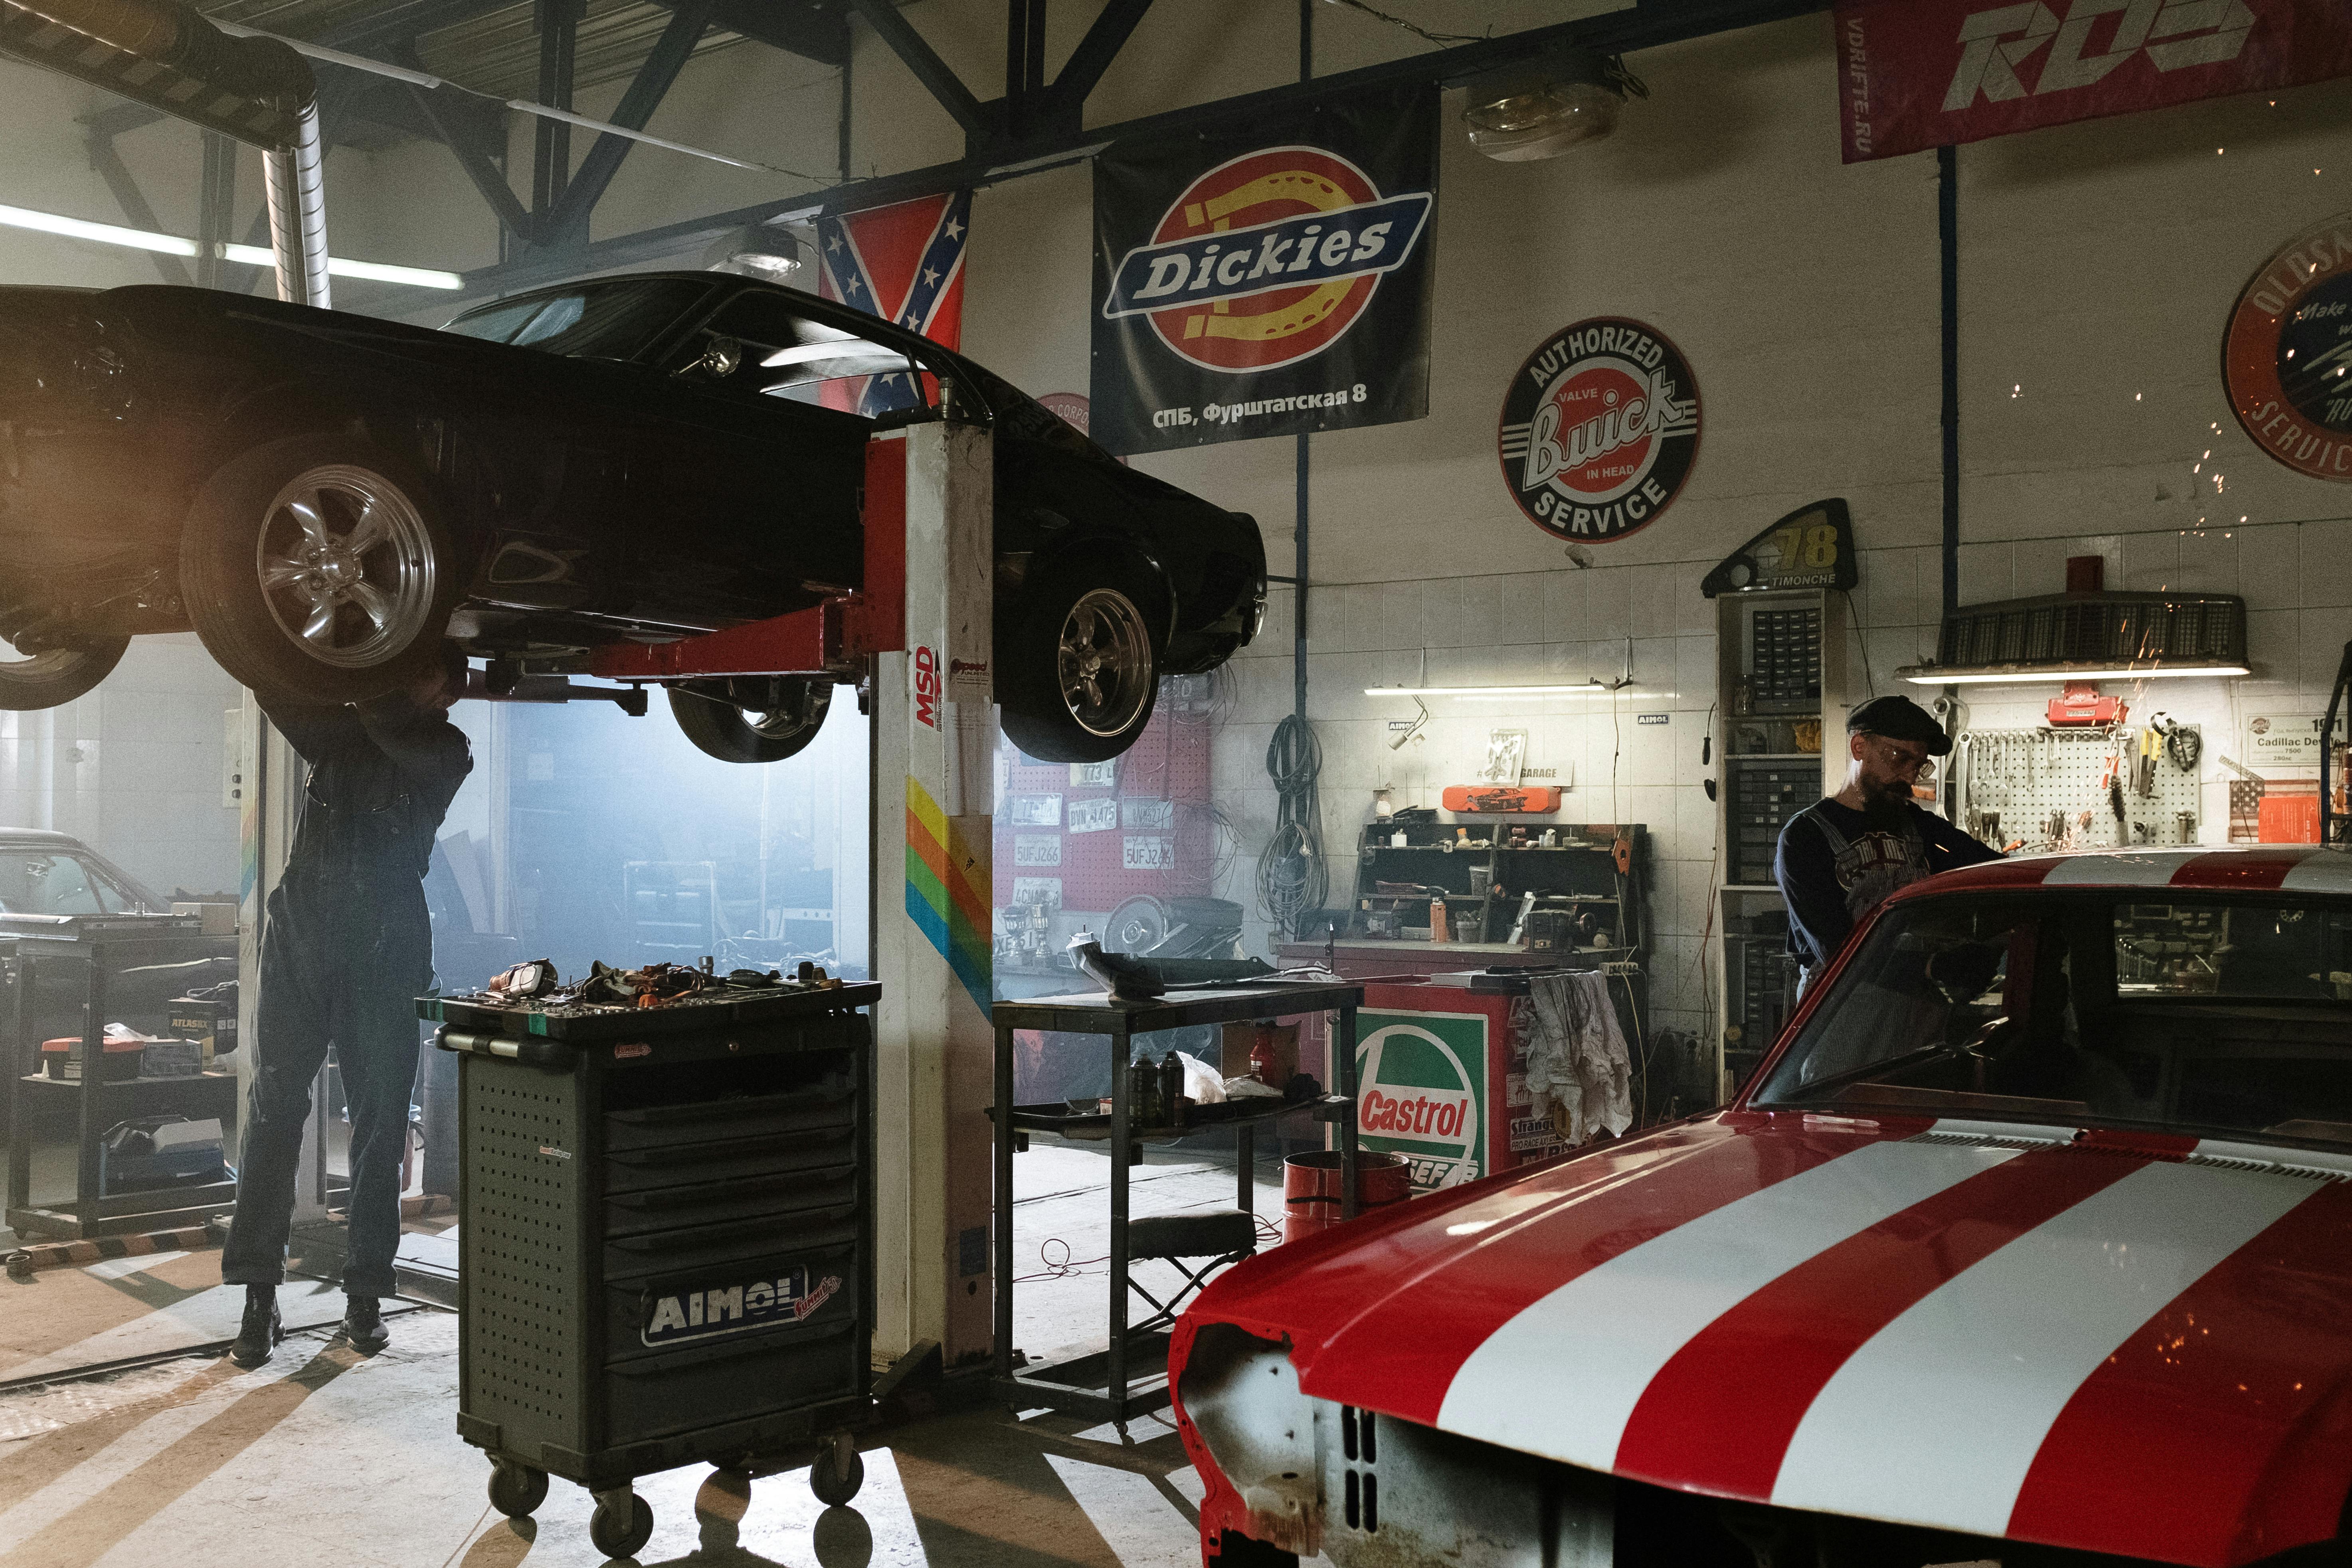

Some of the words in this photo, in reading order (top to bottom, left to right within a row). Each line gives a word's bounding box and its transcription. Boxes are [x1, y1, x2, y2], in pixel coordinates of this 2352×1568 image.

[1847, 17, 1871, 153] VDRIFTE.RU
[1133, 222, 1393, 299] Dickies
[1529, 327, 1663, 388] AUTHORIZED
[1058, 404, 1089, 426] CORPO
[1153, 407, 1198, 428] СПБ,
[1203, 387, 1348, 424] Фурштатская
[1352, 384, 1367, 402] 8
[1559, 388, 1598, 403] VALVE
[1523, 365, 1685, 492] Buick
[1587, 469, 1599, 480] IN
[1602, 465, 1635, 478] HEAD
[1535, 478, 1667, 534] SERVICE
[1776, 525, 1838, 572] 78
[916, 646, 934, 728] MSD
[2257, 738, 2301, 746] Cadillac
[2312, 718, 2342, 732] 191
[1084, 765, 1102, 781] 773
[1520, 769, 1557, 778] GARAGE
[1017, 846, 1058, 862] 5UFJ266
[1361, 1090, 1468, 1137] Castrol
[1524, 1139, 1539, 1148] RACE
[649, 1278, 800, 1334] AIMOL
